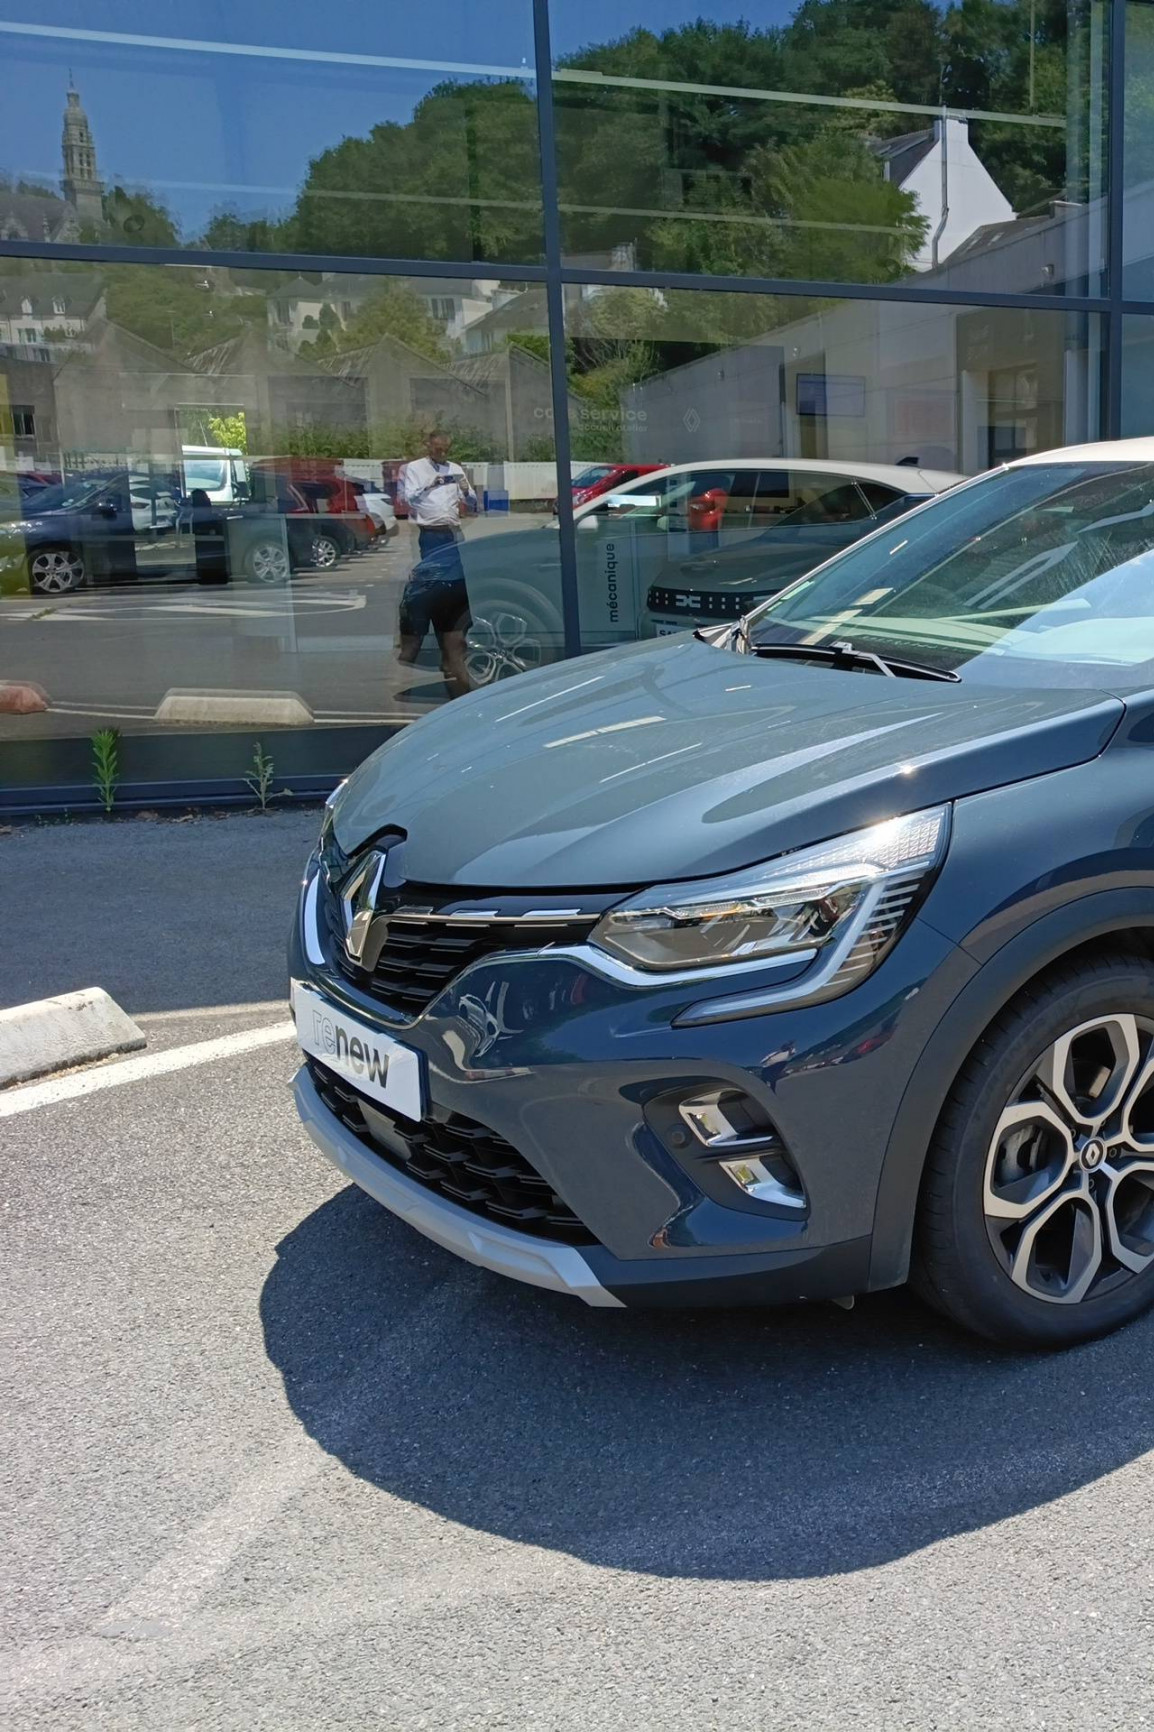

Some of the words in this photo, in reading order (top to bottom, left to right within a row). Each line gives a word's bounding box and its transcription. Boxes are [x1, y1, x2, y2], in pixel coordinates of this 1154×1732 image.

[579, 404, 648, 421] service
[605, 543, 619, 623] mécanique
[312, 1009, 390, 1089] renew
